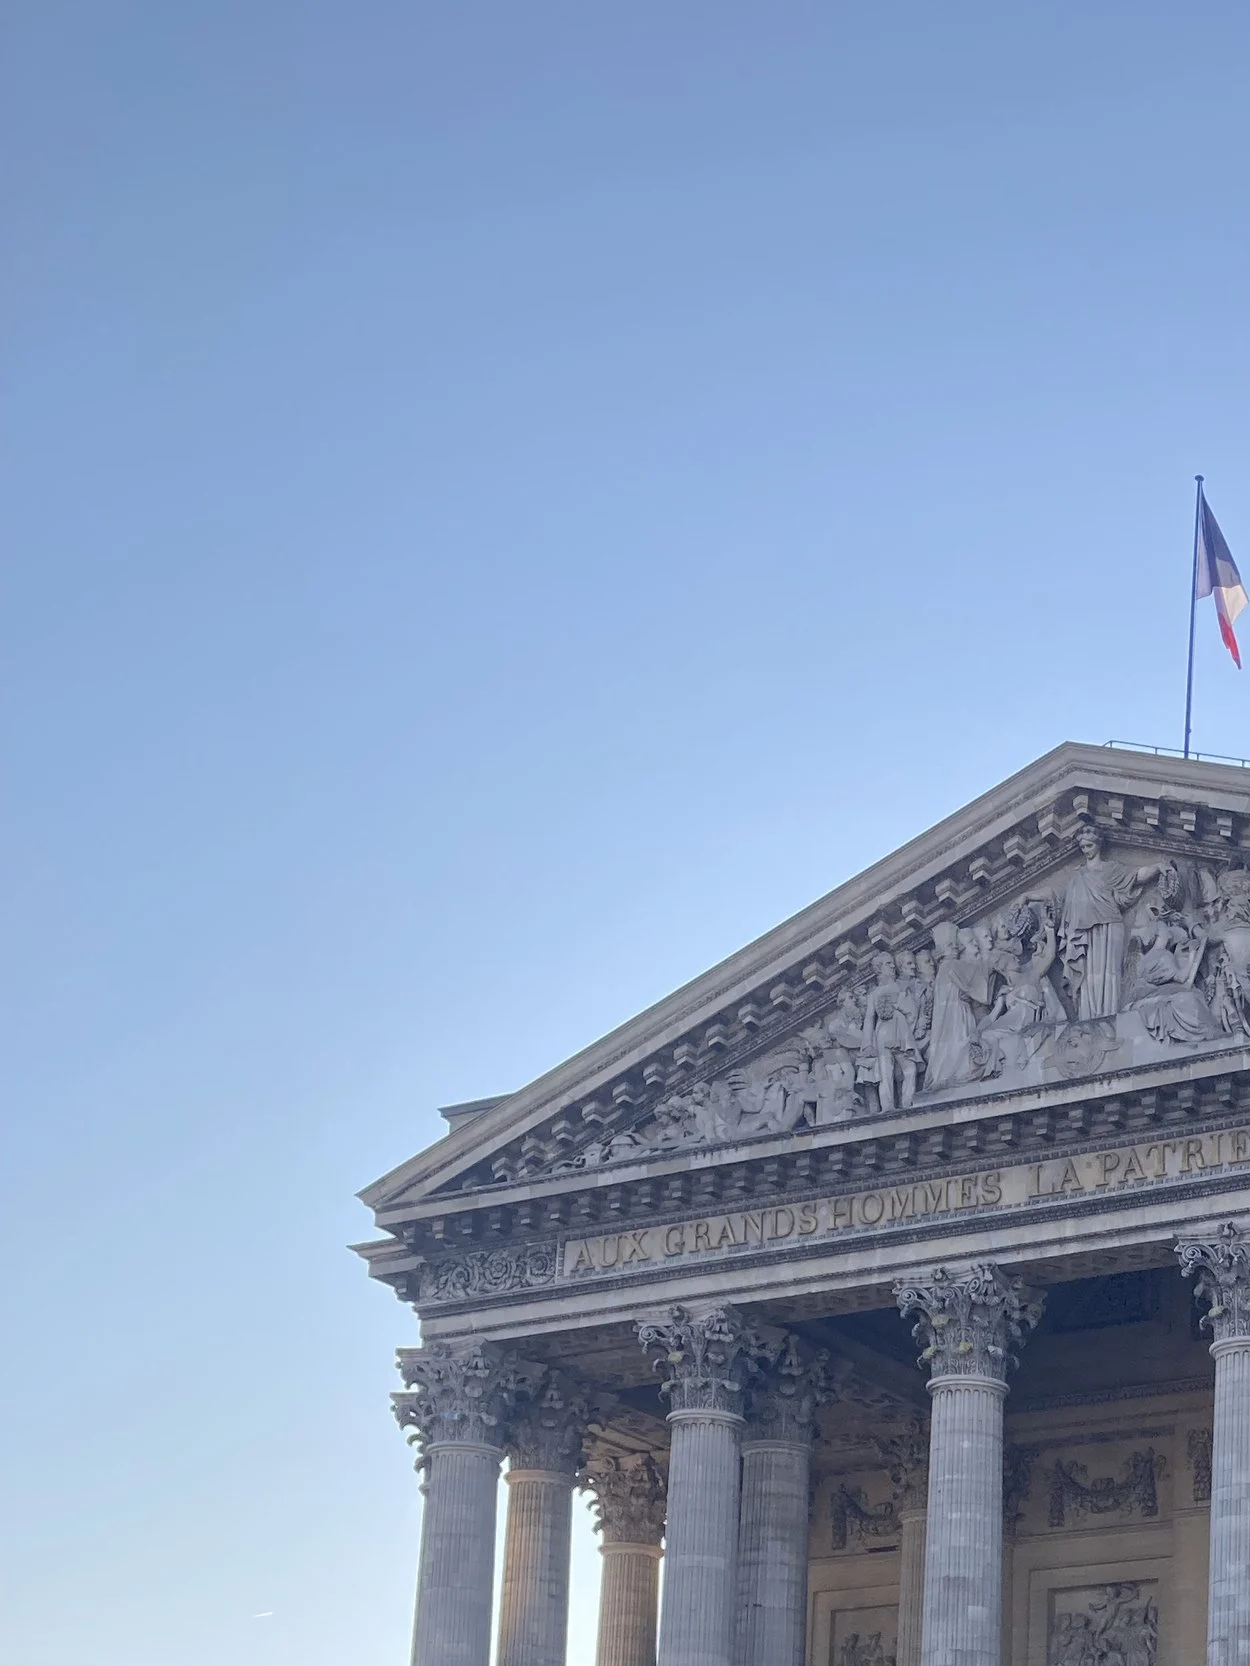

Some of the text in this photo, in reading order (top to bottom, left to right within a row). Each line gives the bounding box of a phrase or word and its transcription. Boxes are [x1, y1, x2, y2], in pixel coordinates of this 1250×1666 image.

[572, 1230, 649, 1272] AUX
[662, 1202, 819, 1258] GRANDS
[827, 1171, 1003, 1231] HOMMES
[1028, 1158, 1084, 1199] LA
